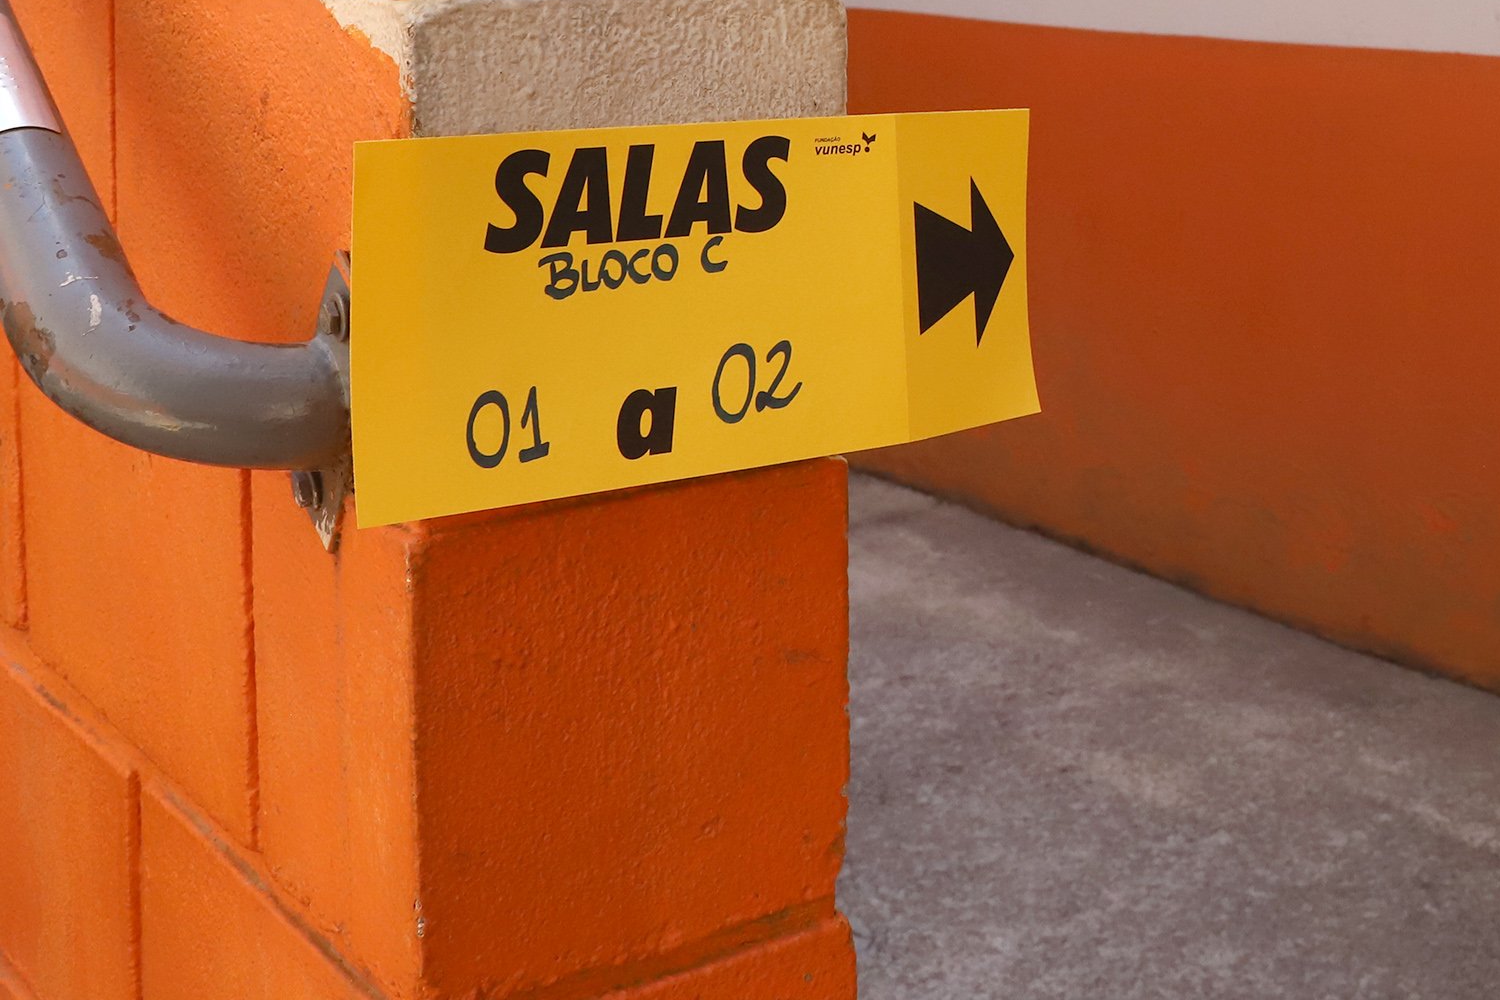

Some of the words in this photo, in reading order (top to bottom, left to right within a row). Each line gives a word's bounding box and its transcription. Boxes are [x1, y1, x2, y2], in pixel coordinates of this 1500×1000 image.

[483, 135, 791, 254] SALAS
[815, 144, 861, 156] vunesp
[538, 243, 680, 300] BLOCO
[701, 236, 729, 273] C
[466, 386, 550, 468] 01
[616, 386, 678, 460] a
[711, 340, 803, 424] 02
